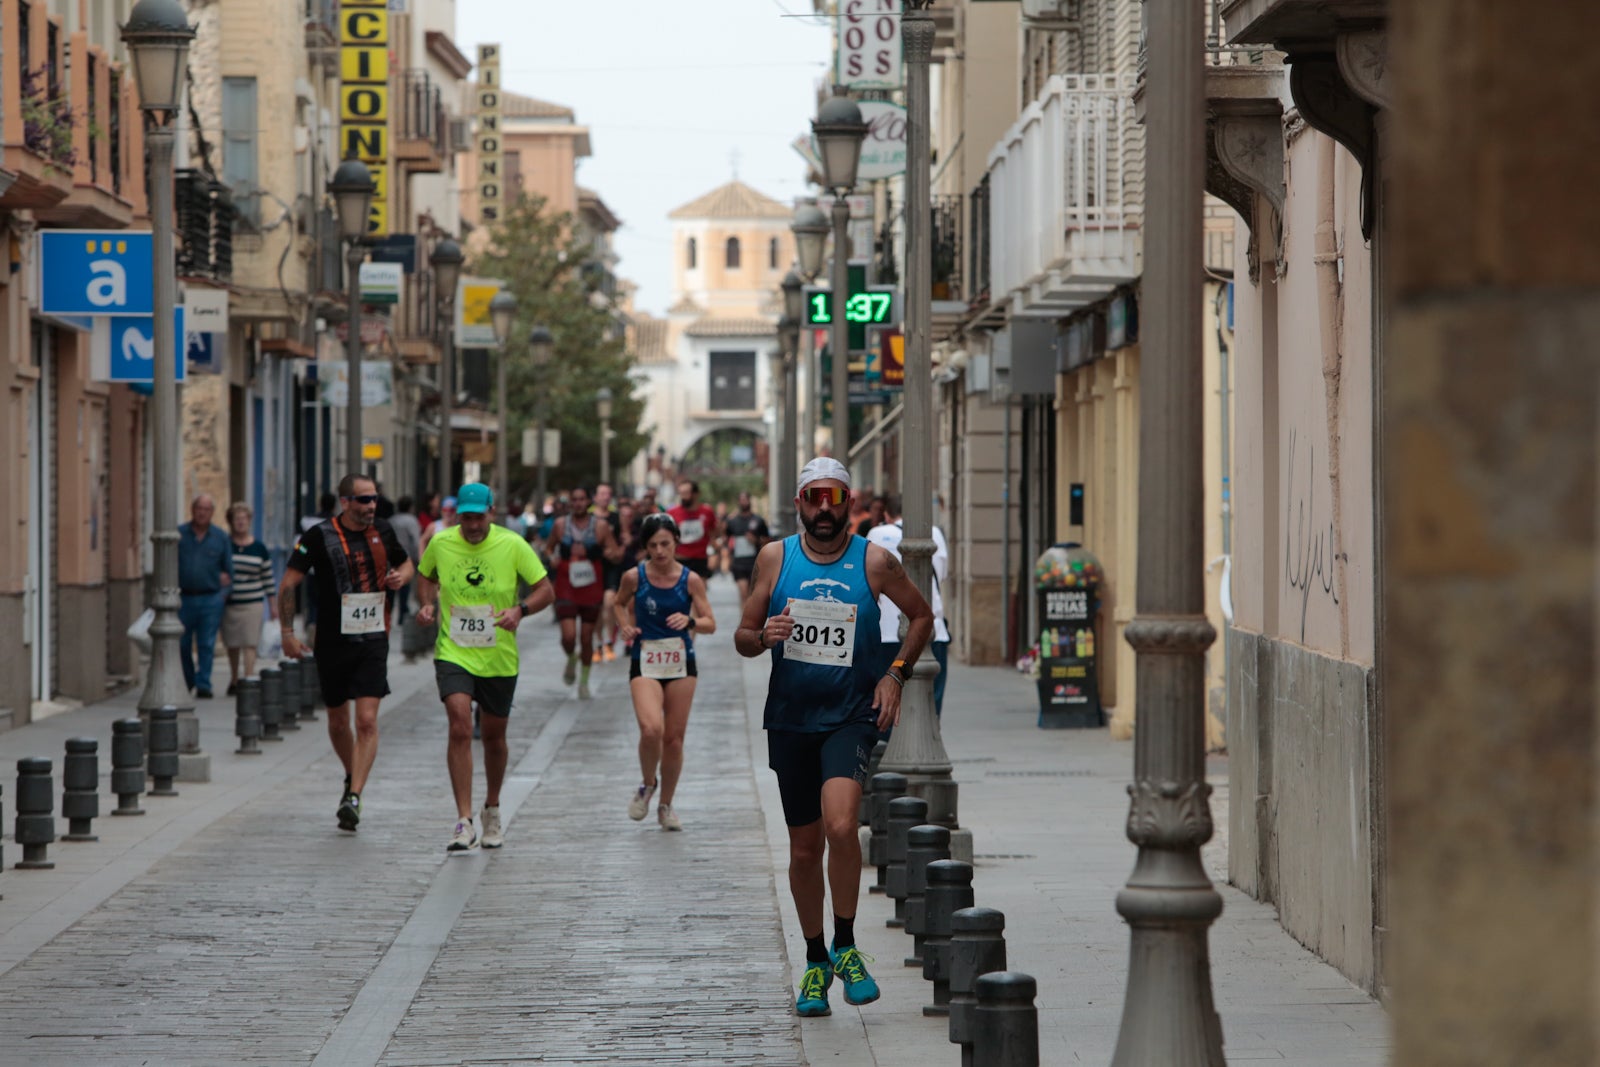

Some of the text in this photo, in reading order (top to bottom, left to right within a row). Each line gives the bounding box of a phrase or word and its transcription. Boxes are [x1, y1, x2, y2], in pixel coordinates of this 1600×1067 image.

[482, 48, 498, 219] PIONONOS
[812, 293, 892, 323] 1:37
[1045, 591, 1087, 601] BEBIDAS
[352, 607, 376, 620] 414
[460, 618, 485, 632] 783
[792, 623, 846, 647] 3013
[646, 651, 681, 664] 2178
